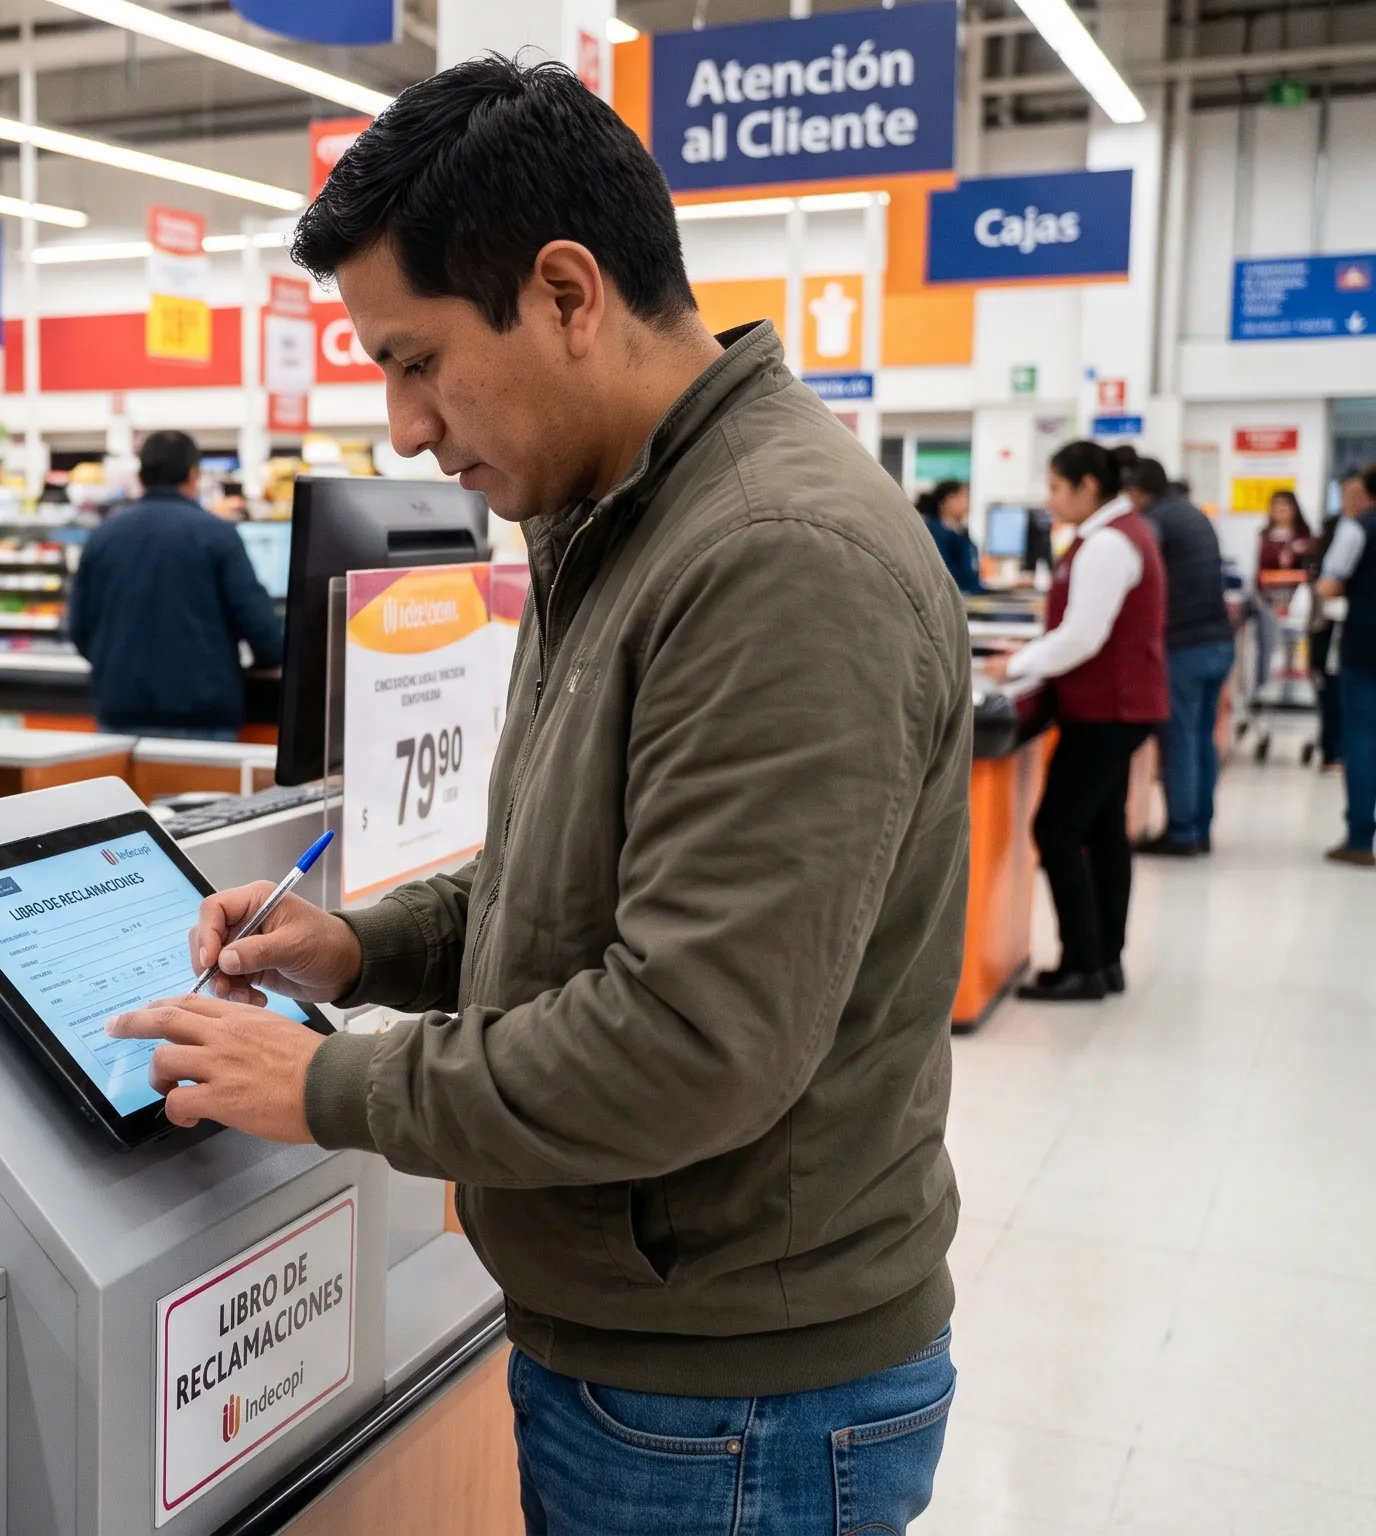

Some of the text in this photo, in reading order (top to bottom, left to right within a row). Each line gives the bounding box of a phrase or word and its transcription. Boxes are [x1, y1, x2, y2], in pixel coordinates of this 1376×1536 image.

[686, 39, 915, 107] Atención
[682, 102, 918, 164] al Cliente
[974, 205, 1081, 254] Cajas
[396, 725, 463, 827] 79 90
[8, 872, 145, 921] LIBRO DE RECLAMACIONES
[219, 1252, 308, 1337] LIBRO DE
[176, 1273, 344, 1410] RECLAMACIONES
[245, 1360, 305, 1423] Indecopi
